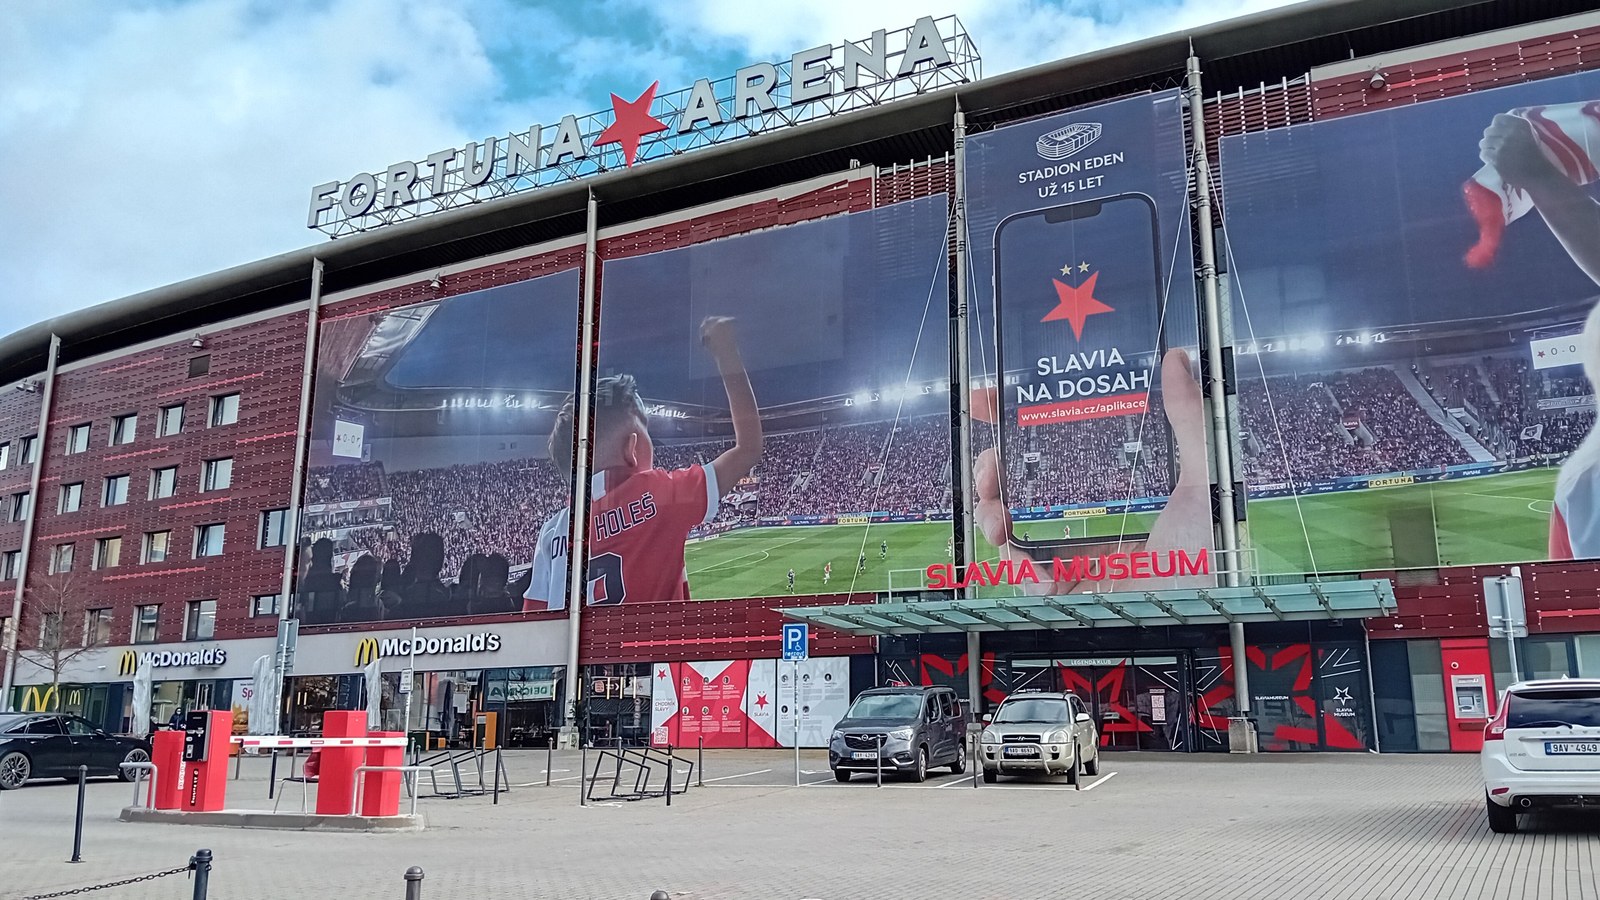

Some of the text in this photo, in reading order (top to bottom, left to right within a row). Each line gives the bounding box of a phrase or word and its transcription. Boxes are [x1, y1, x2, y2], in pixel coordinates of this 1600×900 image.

[307, 15, 952, 228] FORTUNA ARENA
[1018, 151, 1125, 184] STADION EDEN
[1038, 175, 1105, 198] UŽ 15 LET
[1037, 347, 1126, 377] SLAVIA
[1017, 369, 1149, 404] NA DOSAH
[1021, 399, 1146, 422] www.slavia.cz/aplikace
[1369, 476, 1413, 487] FORTUNA
[594, 492, 658, 542] HOLEŠ
[838, 517, 868, 525] FORTUNA
[926, 547, 1209, 589] SLAVIA MUSEUM
[380, 632, 502, 657] McDonald's
[787, 629, 802, 650] P
[138, 648, 227, 668] McDonald's
[1553, 742, 1598, 752] 9AV 4949
